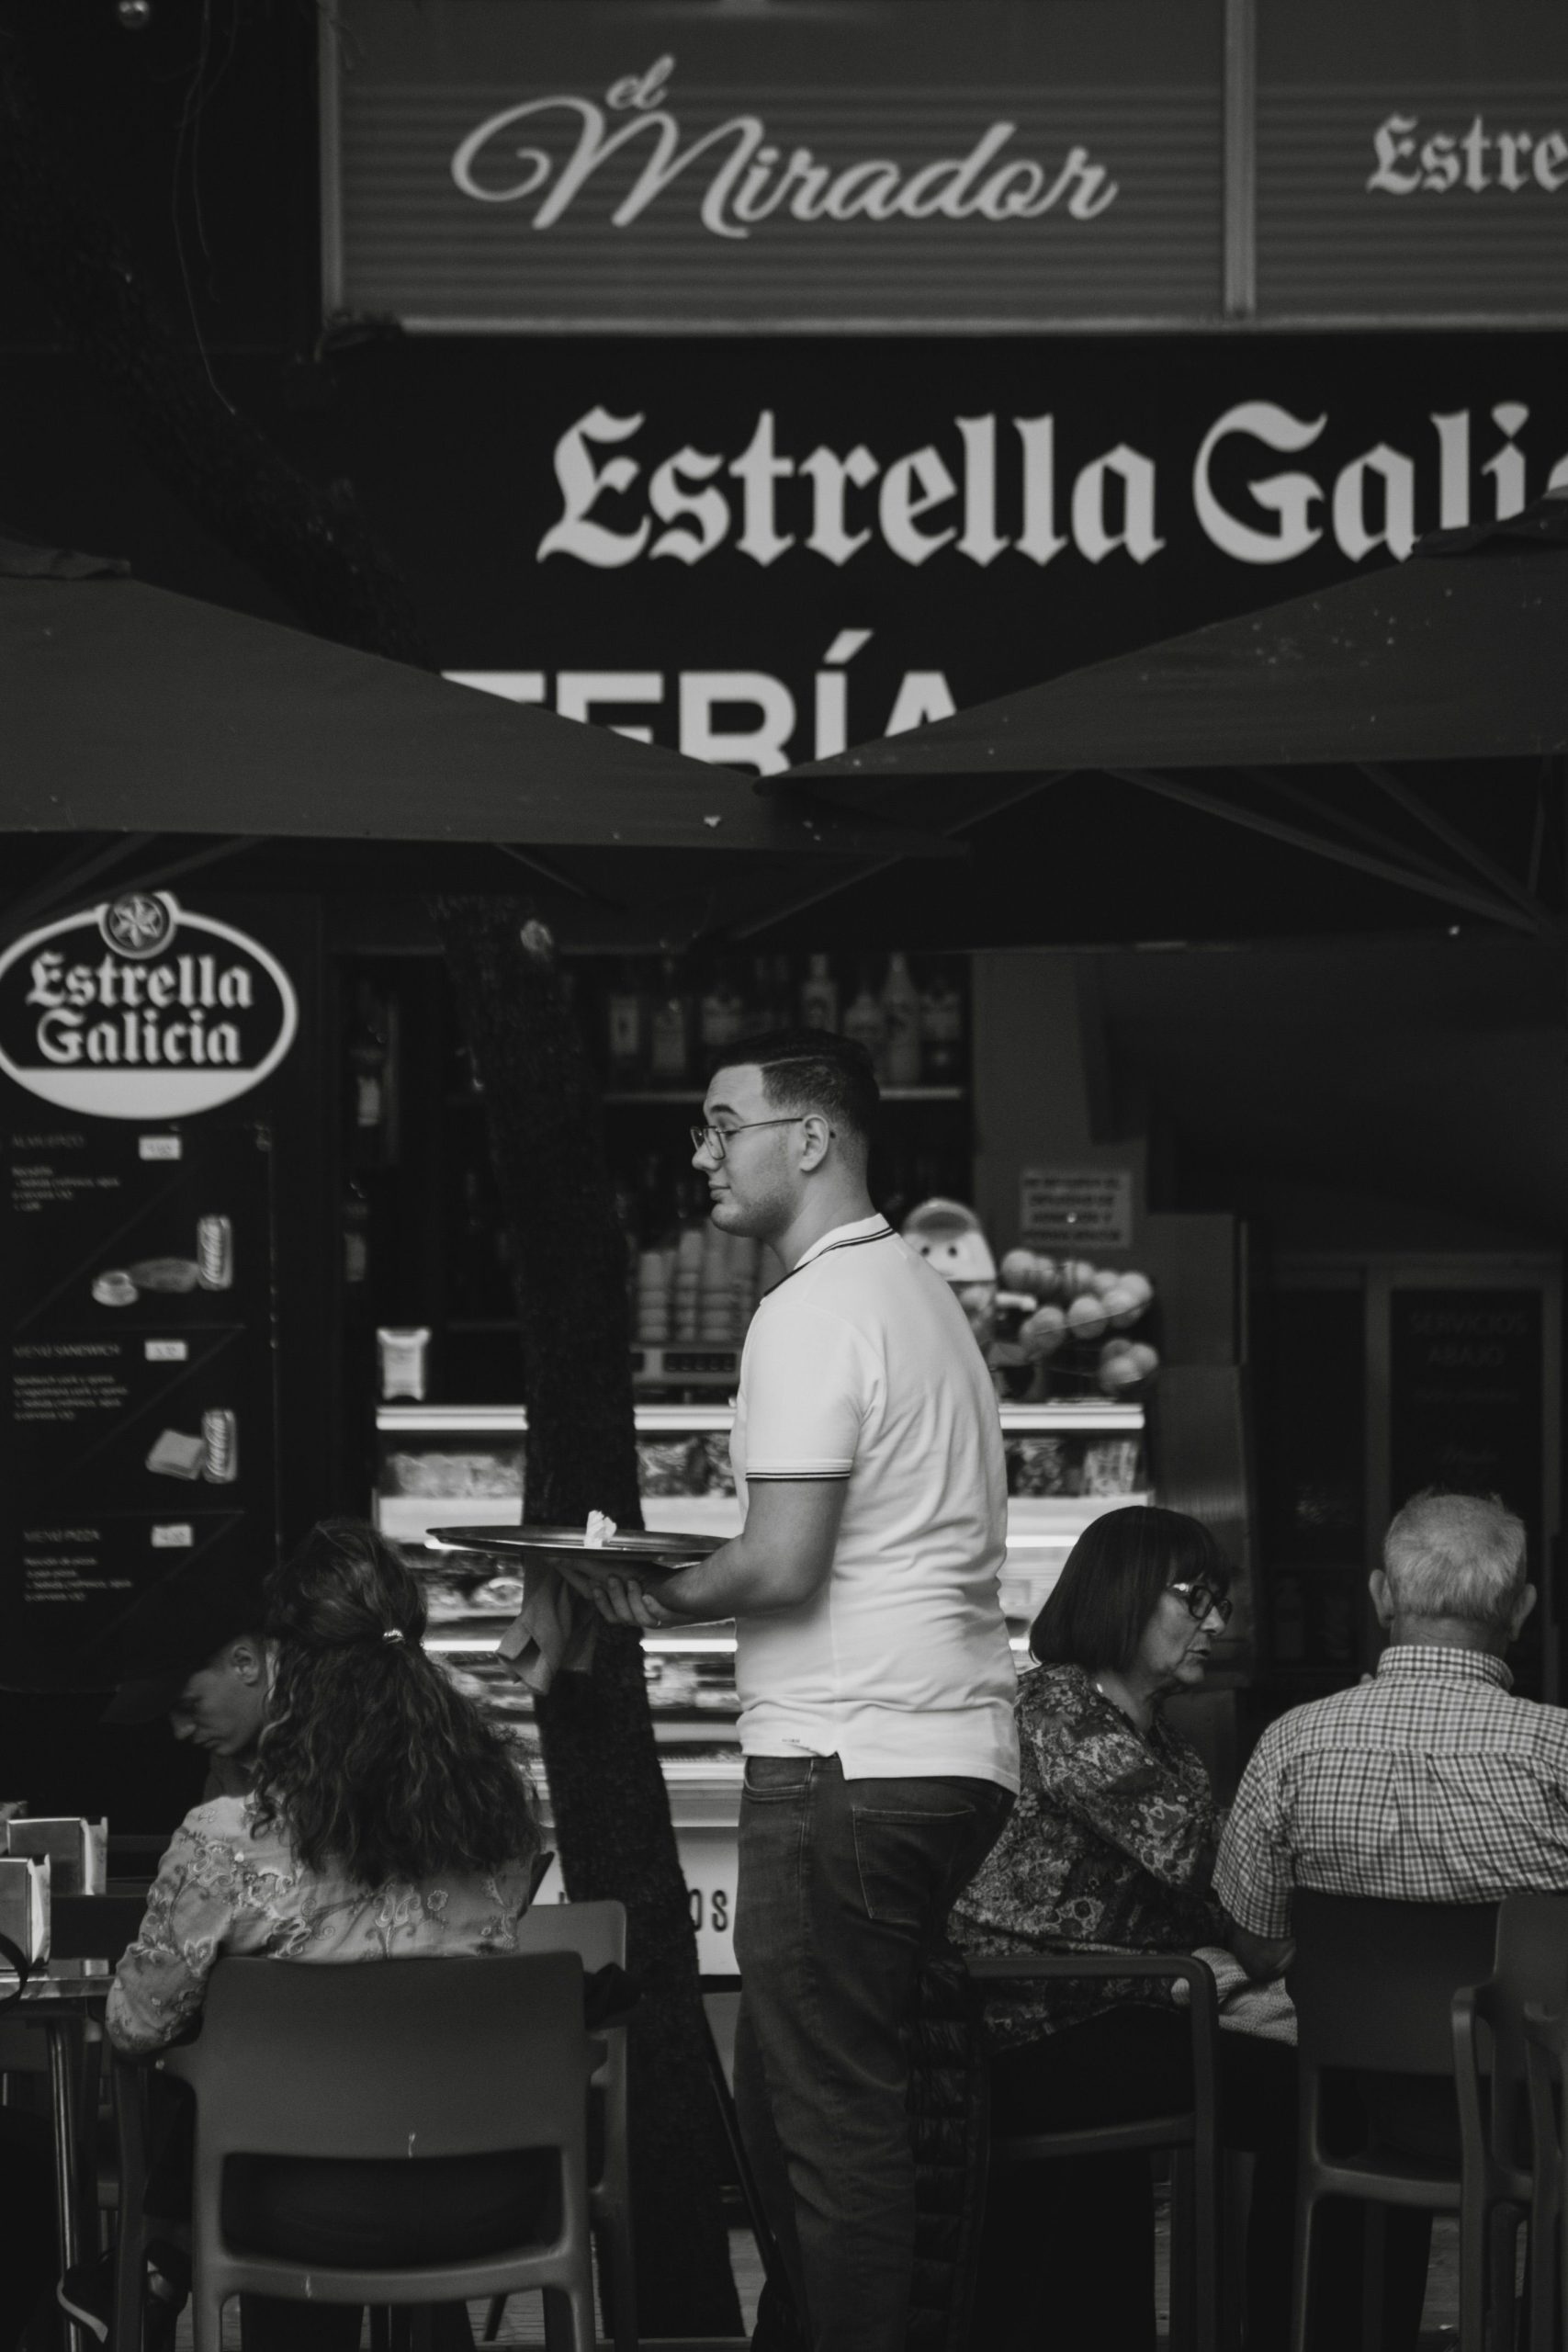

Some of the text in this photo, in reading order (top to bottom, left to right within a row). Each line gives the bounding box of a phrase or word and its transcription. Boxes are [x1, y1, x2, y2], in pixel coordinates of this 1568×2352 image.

[604, 53, 675, 110] el
[450, 95, 1119, 239] Mirador
[536, 400, 1568, 569] Estrella Gali
[25, 950, 254, 1009] Estrella
[36, 1008, 243, 1065] Galicia
